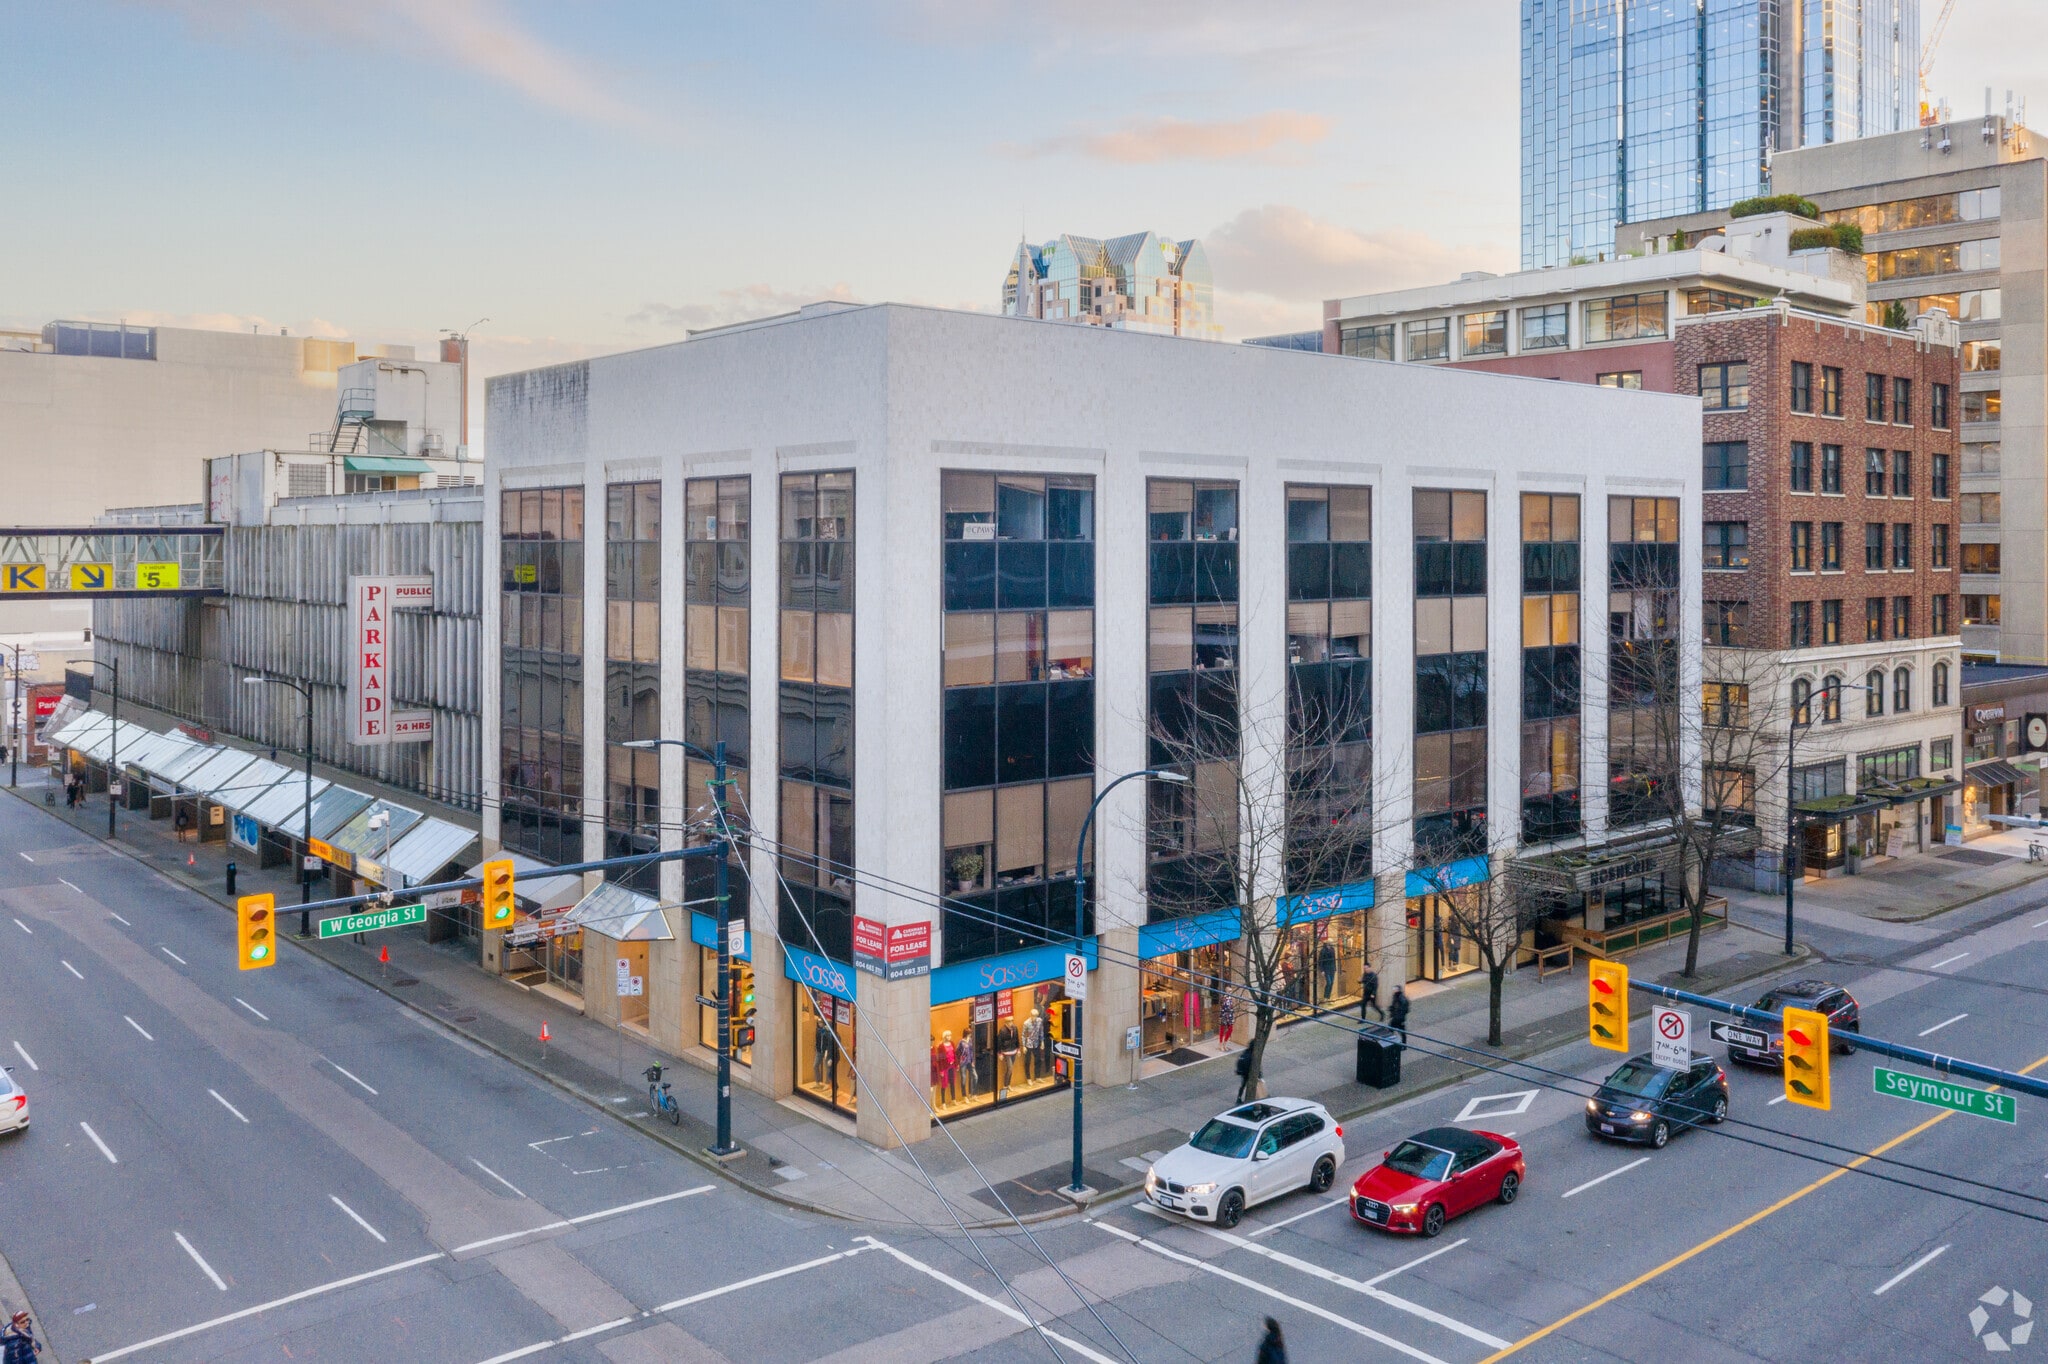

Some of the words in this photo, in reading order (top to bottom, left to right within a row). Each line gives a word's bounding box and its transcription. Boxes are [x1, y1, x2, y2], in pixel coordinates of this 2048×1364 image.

[10, 566, 40, 589] K
[396, 587, 432, 596] PUBLIC
[364, 586, 382, 735] PARKADE
[396, 723, 408, 731] 24
[411, 721, 431, 730] HRS
[331, 920, 343, 932] W
[347, 911, 398, 928] Georgia
[404, 907, 416, 920] St
[856, 936, 867, 944] FOR
[867, 938, 882, 950] LEASE
[890, 945, 904, 953] FOR
[906, 941, 927, 950] LEASE
[998, 999, 1011, 1007] LEASE
[998, 1006, 1011, 1015] SALE
[1728, 1030, 1743, 1041] ONE
[1745, 1034, 1762, 1046] WAY
[1655, 1053, 1671, 1062] EXCEPT
[1673, 1057, 1687, 1066] BUSES
[1886, 1072, 1975, 1106] Seymour
[1984, 1094, 2004, 1114] St
